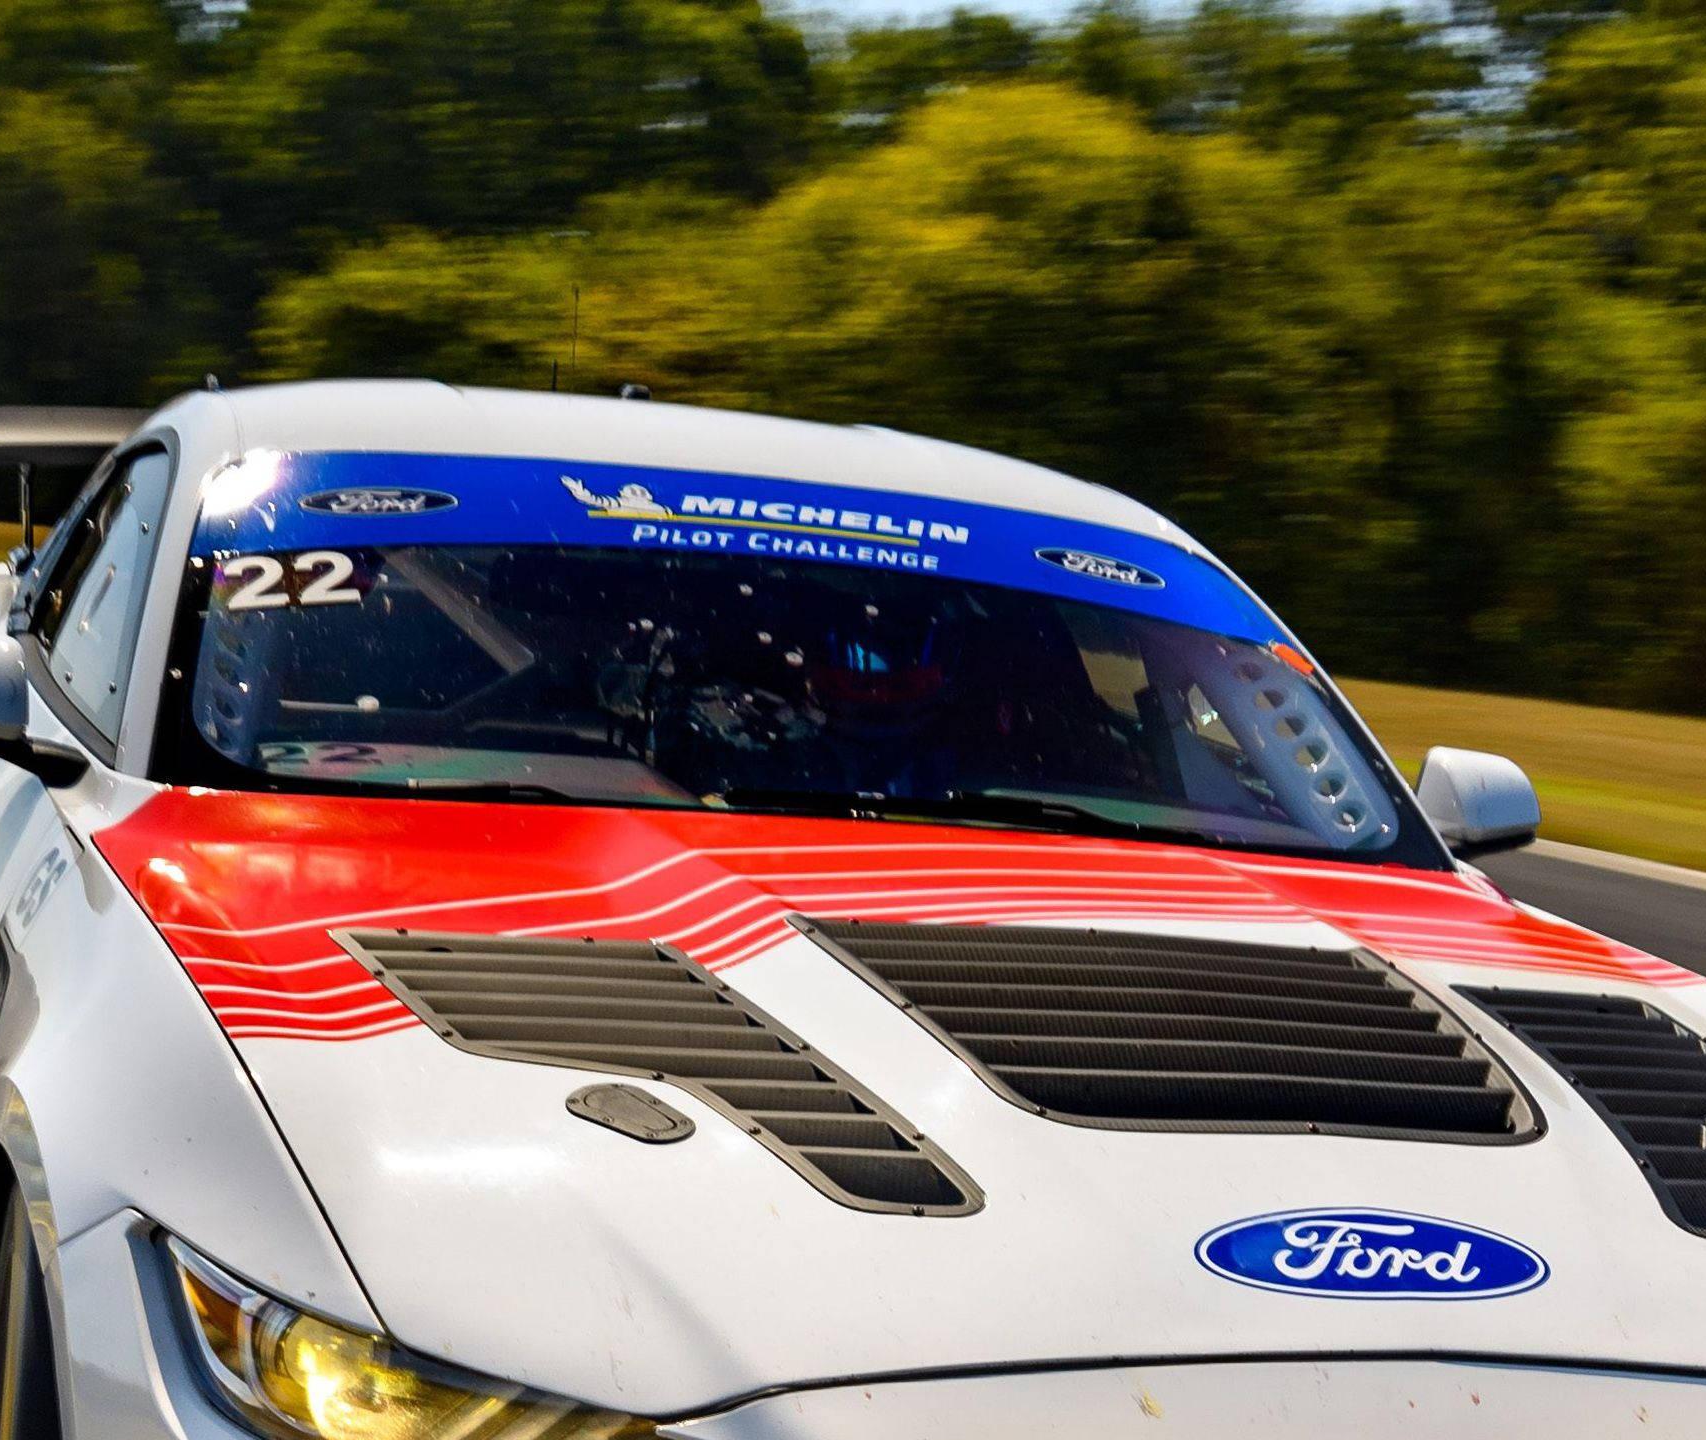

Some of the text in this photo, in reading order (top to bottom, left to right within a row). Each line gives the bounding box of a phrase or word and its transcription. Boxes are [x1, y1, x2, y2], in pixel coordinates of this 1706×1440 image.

[327, 489, 426, 513] Ford
[681, 494, 970, 545] MICHELIN
[632, 524, 940, 572] PILOT CHALLENGE
[1062, 551, 1142, 585] Ford
[224, 550, 362, 611] 22
[1273, 1219, 1481, 1284] Ford
